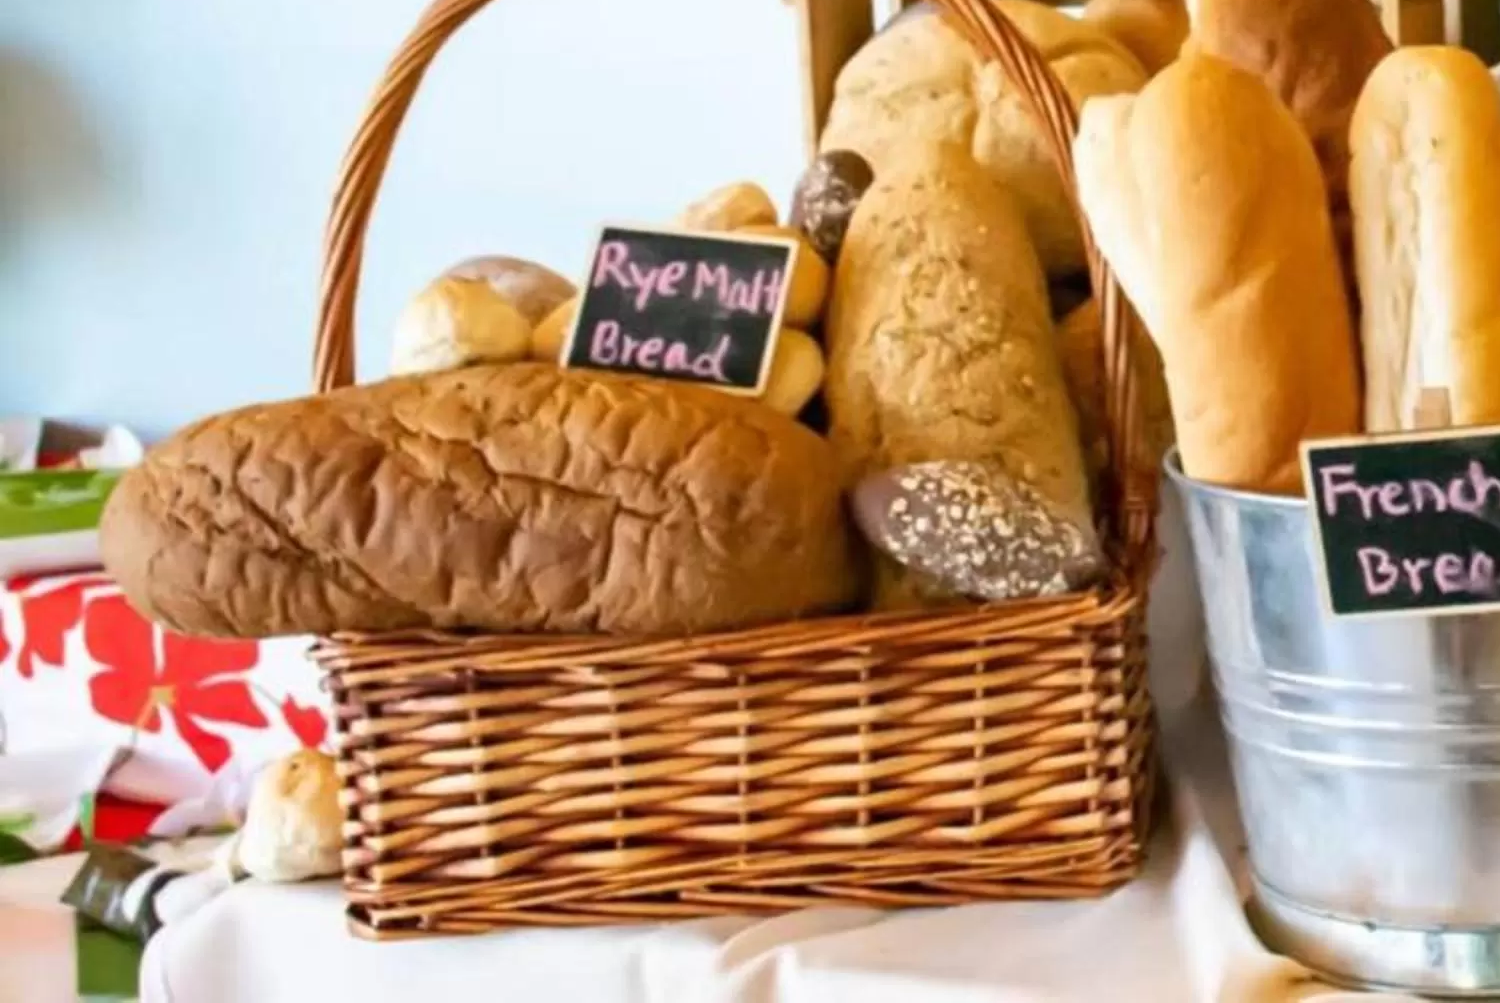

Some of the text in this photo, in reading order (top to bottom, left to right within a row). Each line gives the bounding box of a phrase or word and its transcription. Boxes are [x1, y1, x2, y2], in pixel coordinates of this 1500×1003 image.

[593, 240, 783, 314] Rye Malt
[590, 319, 732, 382] Bread
